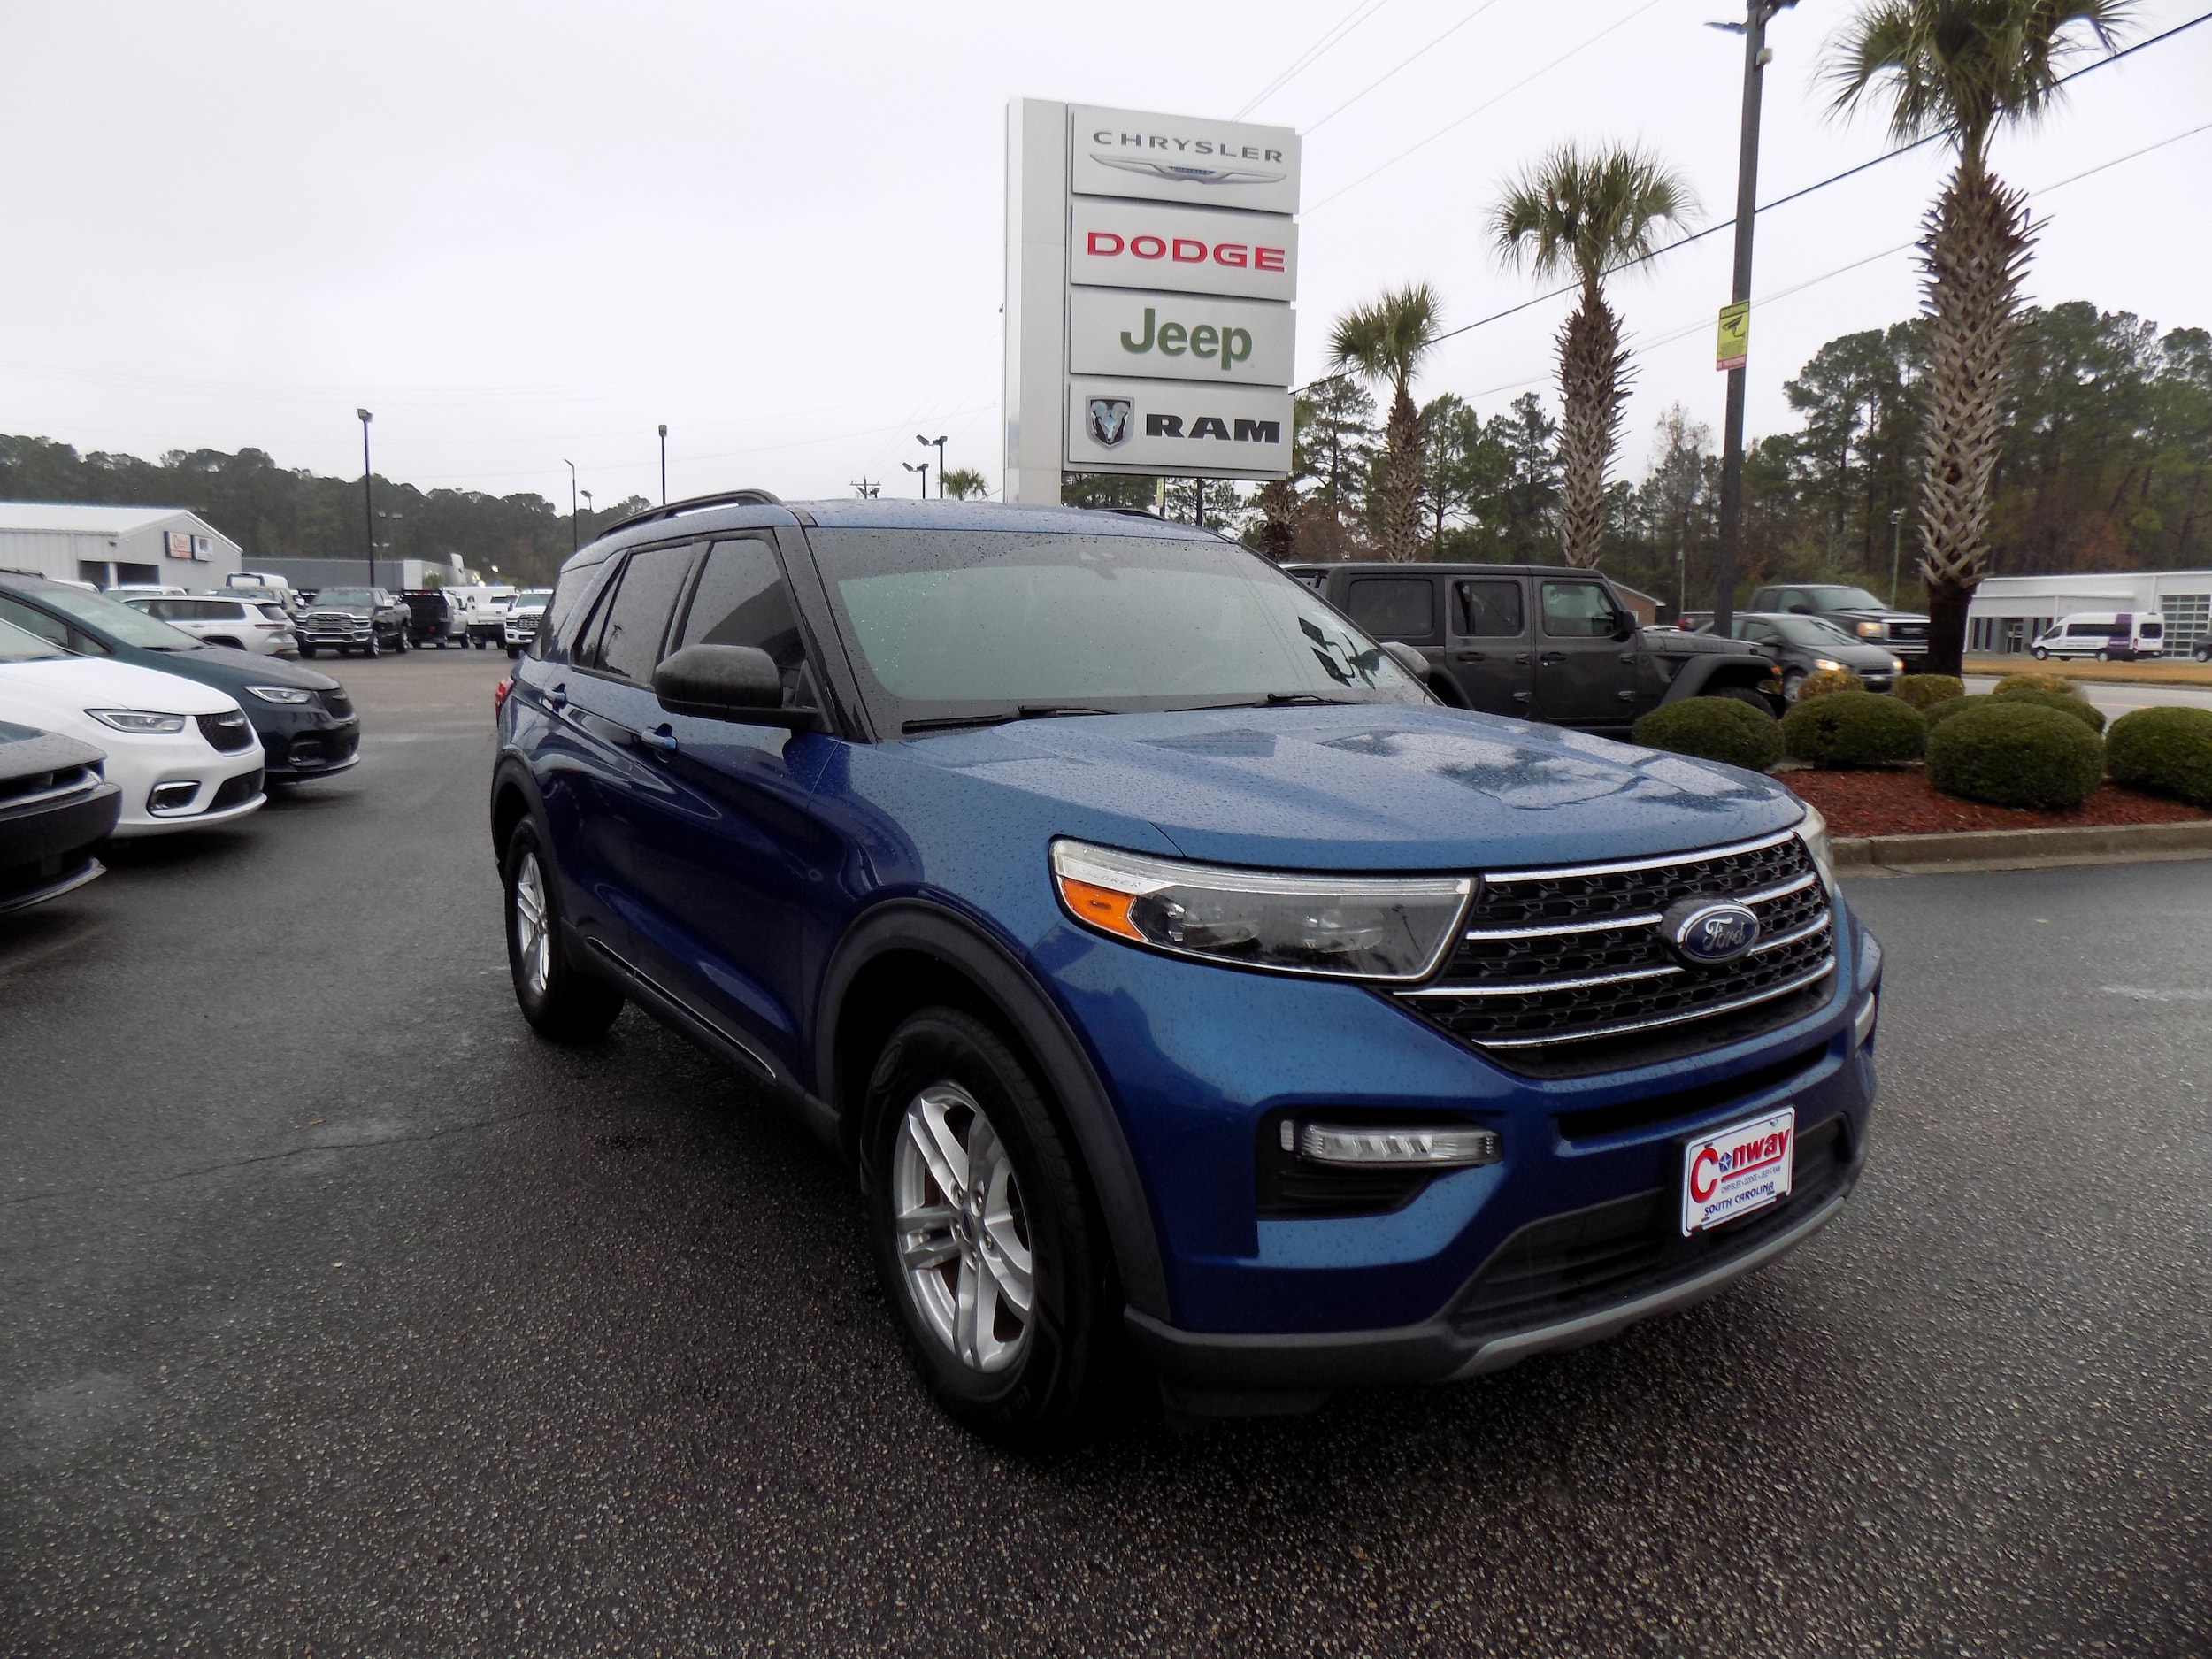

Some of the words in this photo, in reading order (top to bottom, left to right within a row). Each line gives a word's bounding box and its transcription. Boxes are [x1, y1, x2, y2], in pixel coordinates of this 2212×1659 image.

[1093, 131, 1283, 164] CHRYSLER
[1087, 232, 1285, 273] DODGE
[1120, 307, 1253, 371] Jeep
[1146, 413, 1280, 444] RAM
[1702, 917, 1746, 951] Ford
[1704, 1198, 1732, 1217] SOUTH
[1734, 1181, 1774, 1203] CAROLINA
